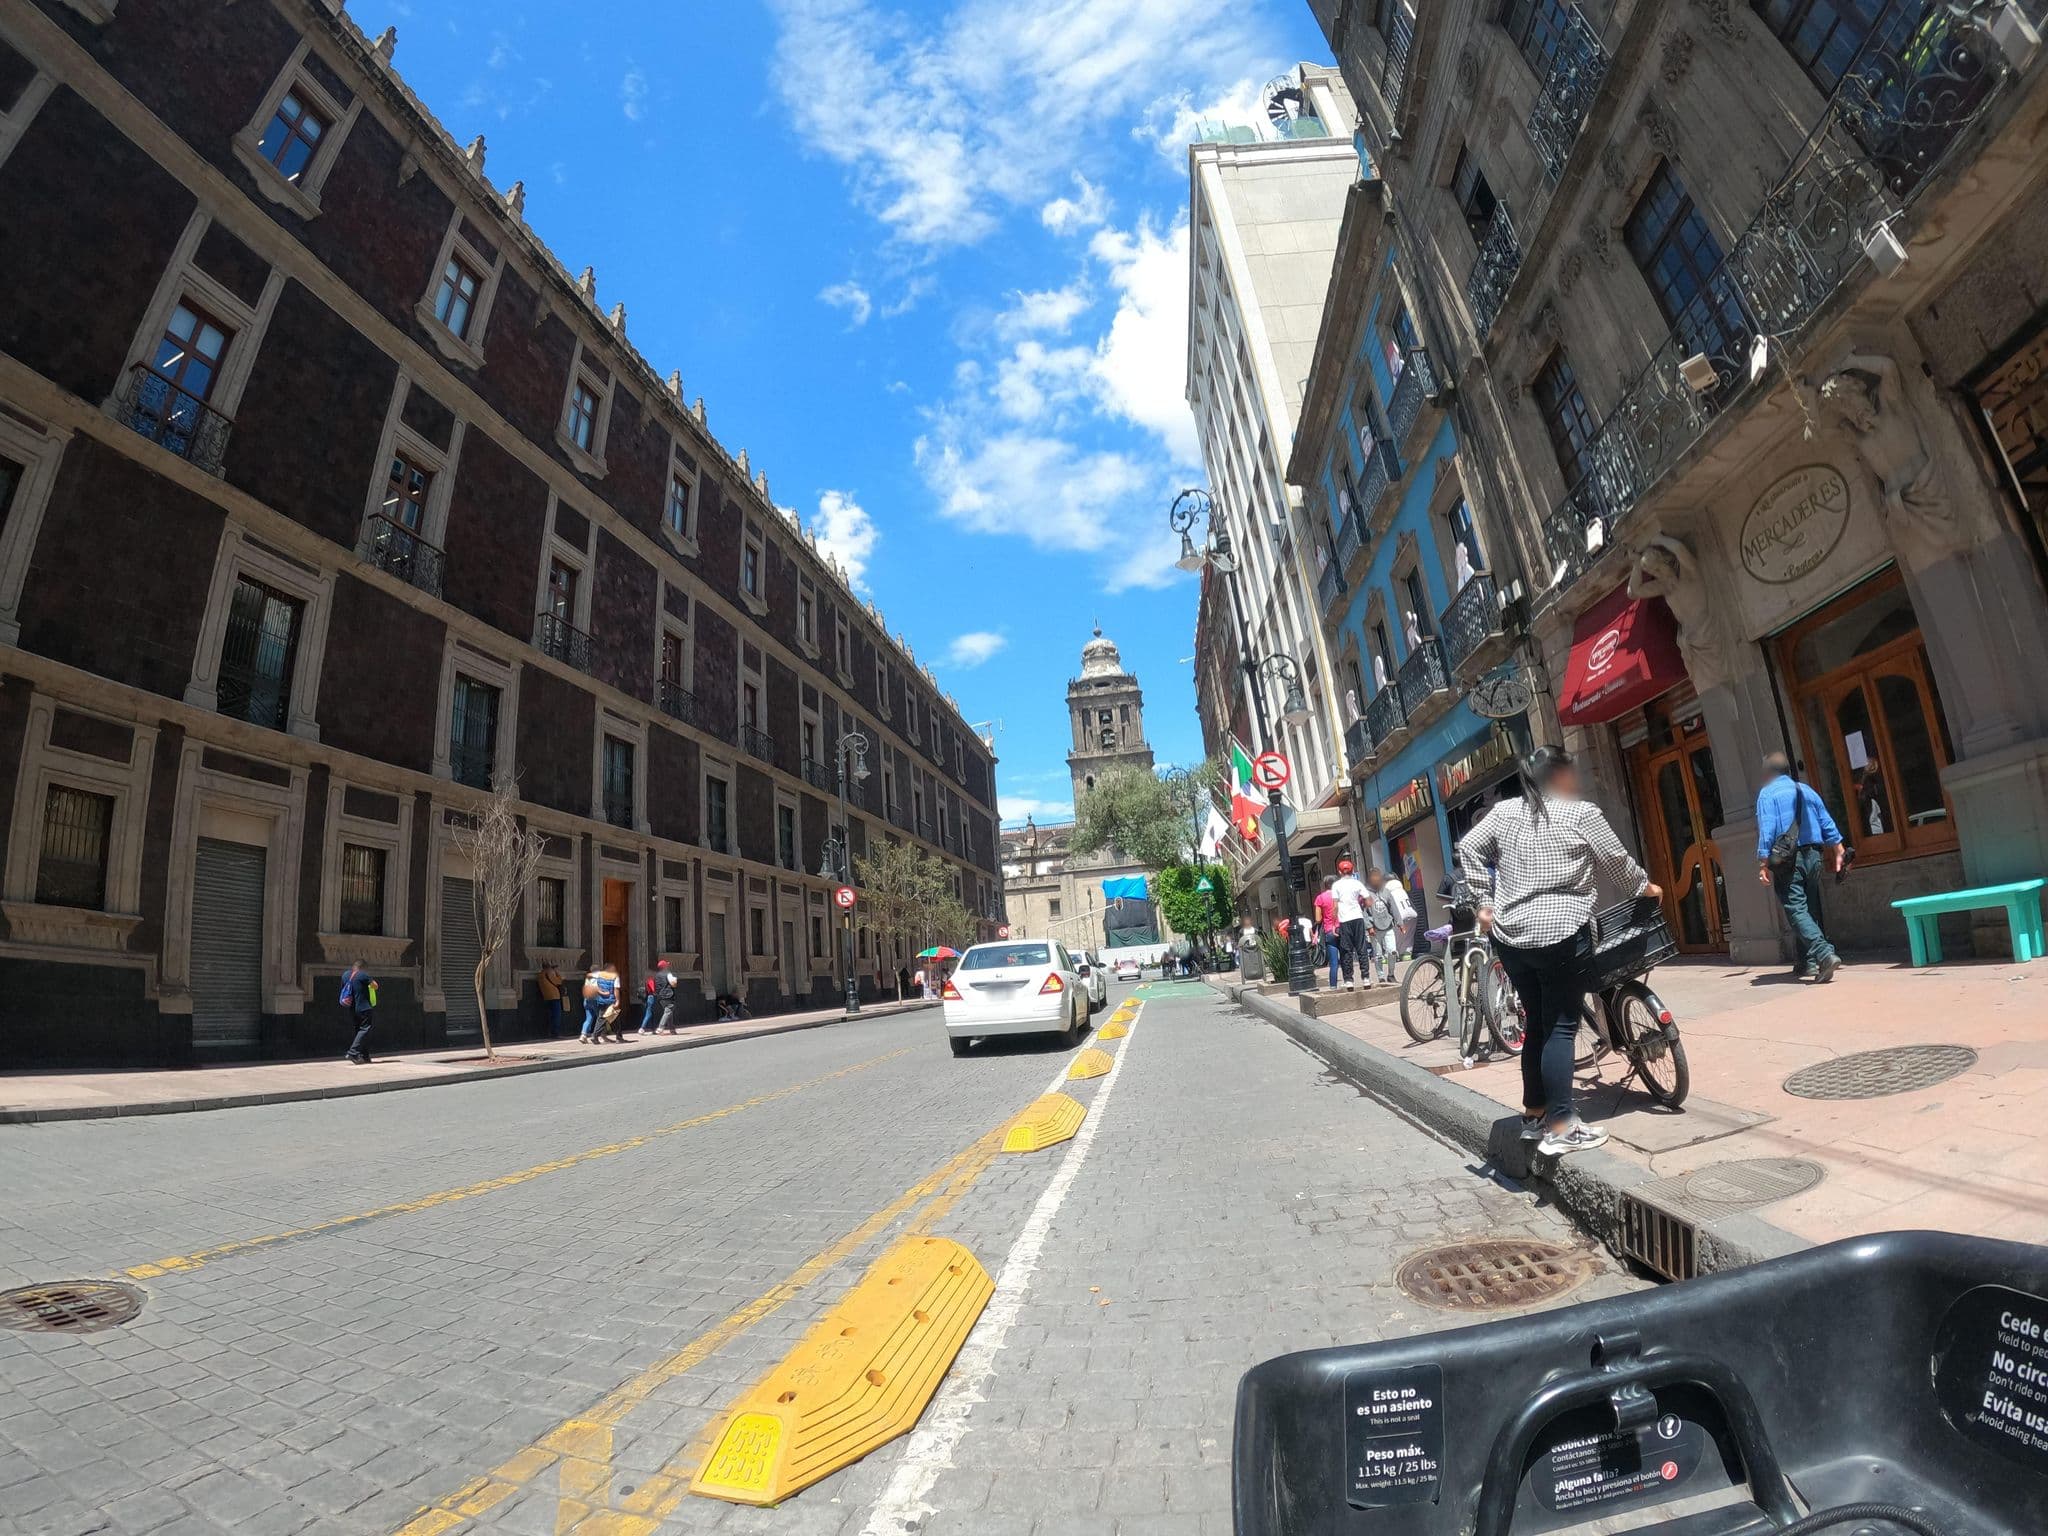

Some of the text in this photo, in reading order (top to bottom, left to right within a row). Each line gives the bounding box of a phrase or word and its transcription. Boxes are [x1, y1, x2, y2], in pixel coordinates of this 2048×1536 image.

[1743, 476, 1844, 568] MERCADERES
[2001, 1311, 2040, 1339] Cede
[1998, 1330, 2020, 1348] Yield
[2021, 1340, 2031, 1352] to
[1992, 1350, 2048, 1387] No circ
[1373, 1388, 1416, 1401] Esto no
[1989, 1370, 2048, 1404] Don't ride on
[1356, 1398, 1433, 1416] es un asiento
[1983, 1390, 2023, 1422] Evita
[1977, 1410, 2005, 1431] Avoid
[2004, 1424, 2030, 1445] using
[1366, 1443, 1425, 1461] Peso máx.
[1551, 1448, 1597, 1464] Contáctanos:
[1358, 1459, 1437, 1478] 11.5 kg / 25 lbs
[1554, 1468, 1619, 1494] ¿Alguna falla?
[1555, 1491, 1575, 1502] Ancla
[1583, 1486, 1596, 1496] bici
[1602, 1477, 1633, 1493] presiona
[1633, 1474, 1640, 1483] el
[1640, 1470, 1661, 1480] botón
